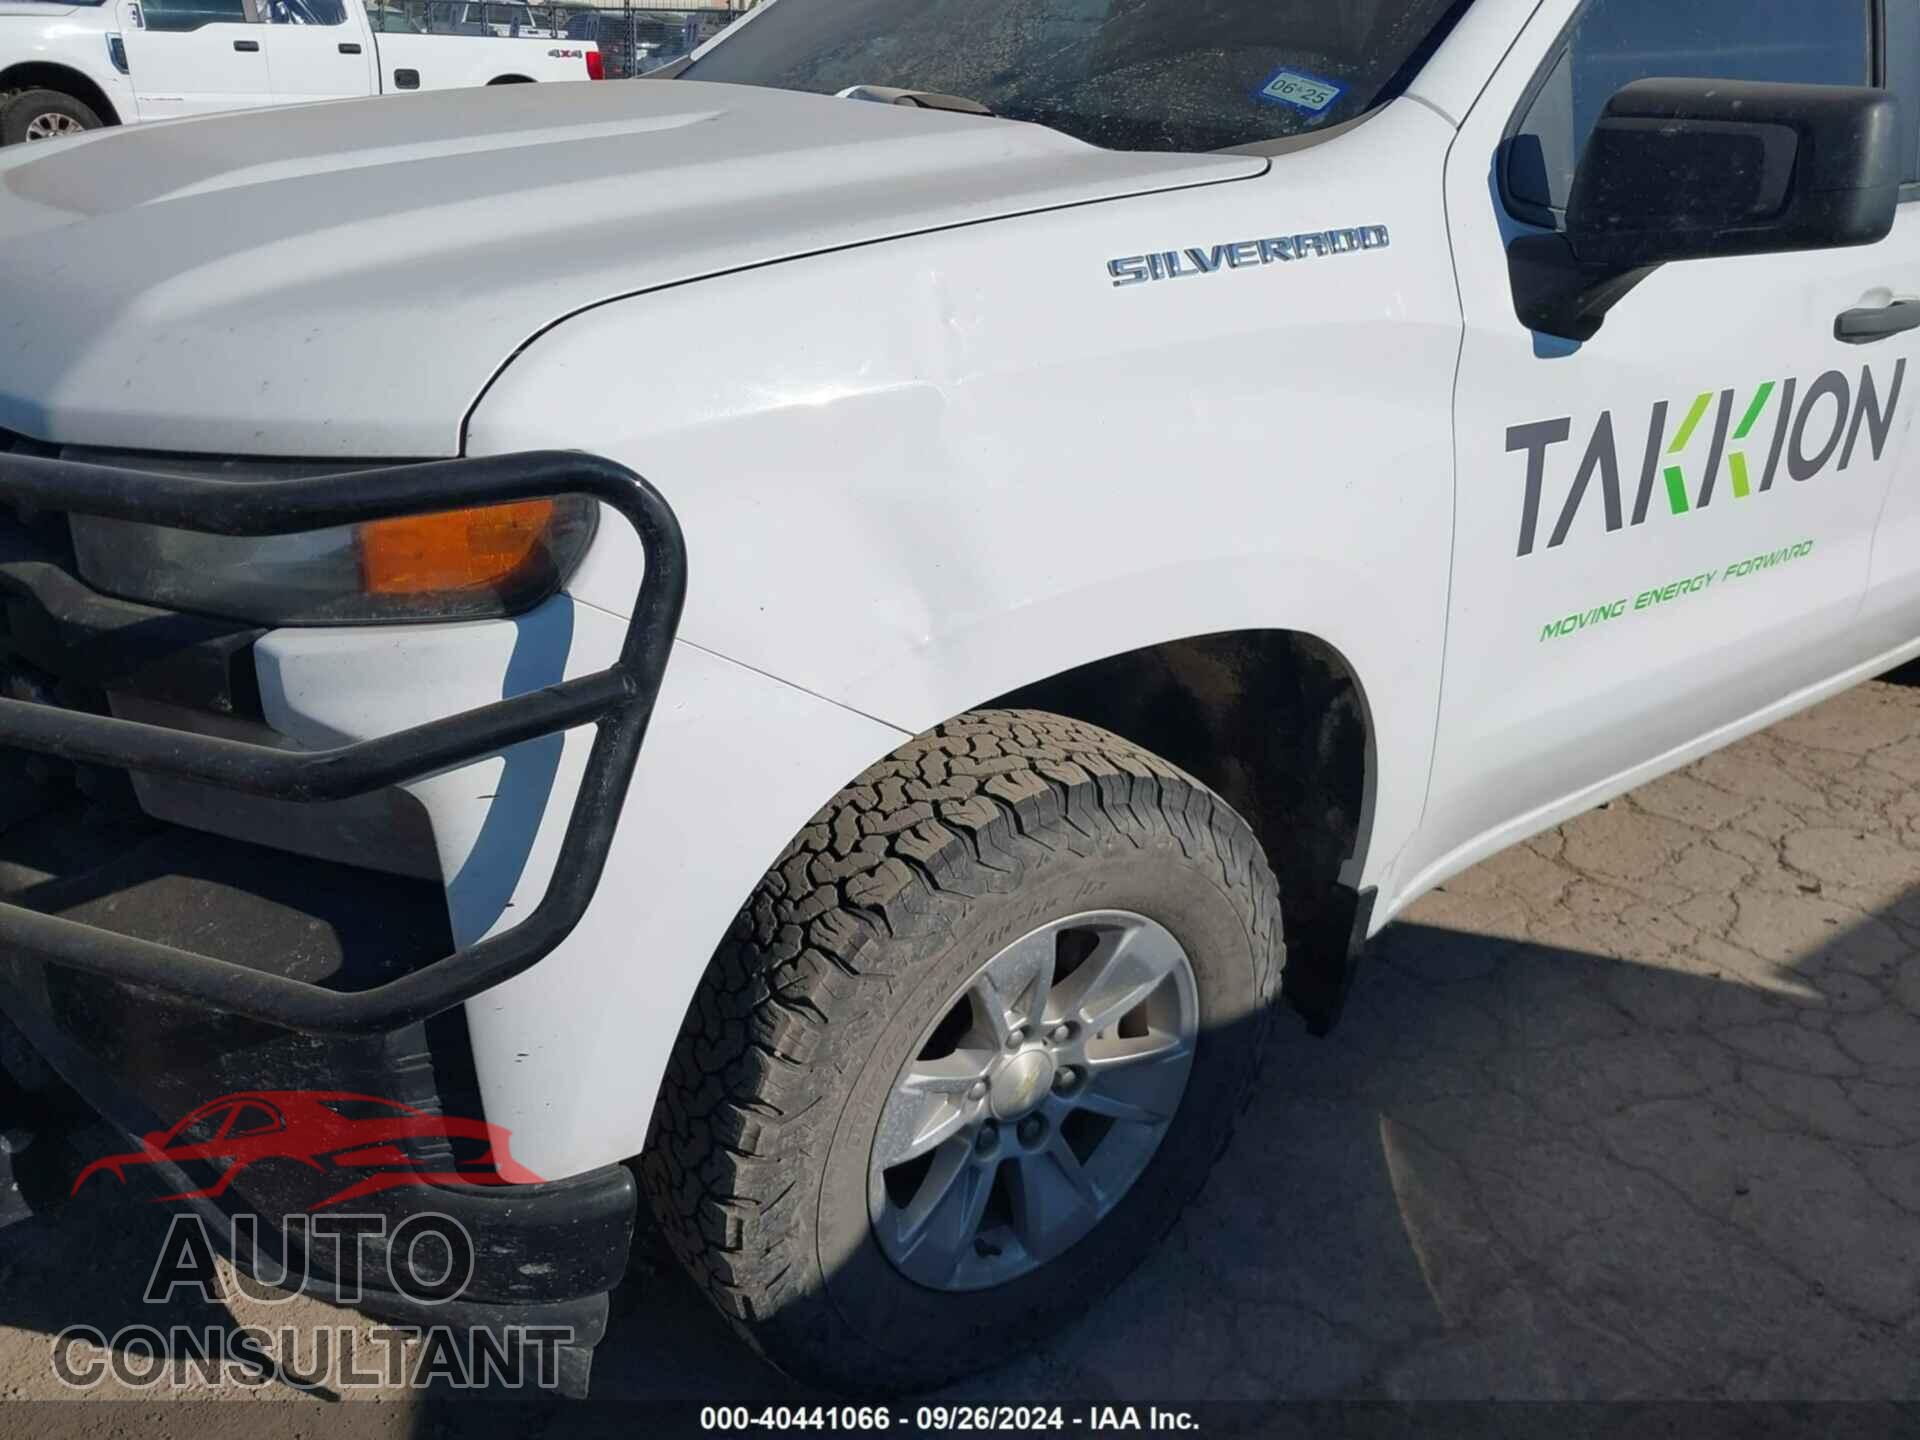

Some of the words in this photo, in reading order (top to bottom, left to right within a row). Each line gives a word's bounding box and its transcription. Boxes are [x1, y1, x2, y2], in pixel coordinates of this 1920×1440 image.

[1107, 223, 1391, 288] SILVERADO
[1505, 357, 1907, 558] TAKKION
[1540, 599, 1627, 643] MOVING
[1634, 569, 1718, 611] ENERGY
[1723, 539, 1814, 583] FORWARD
